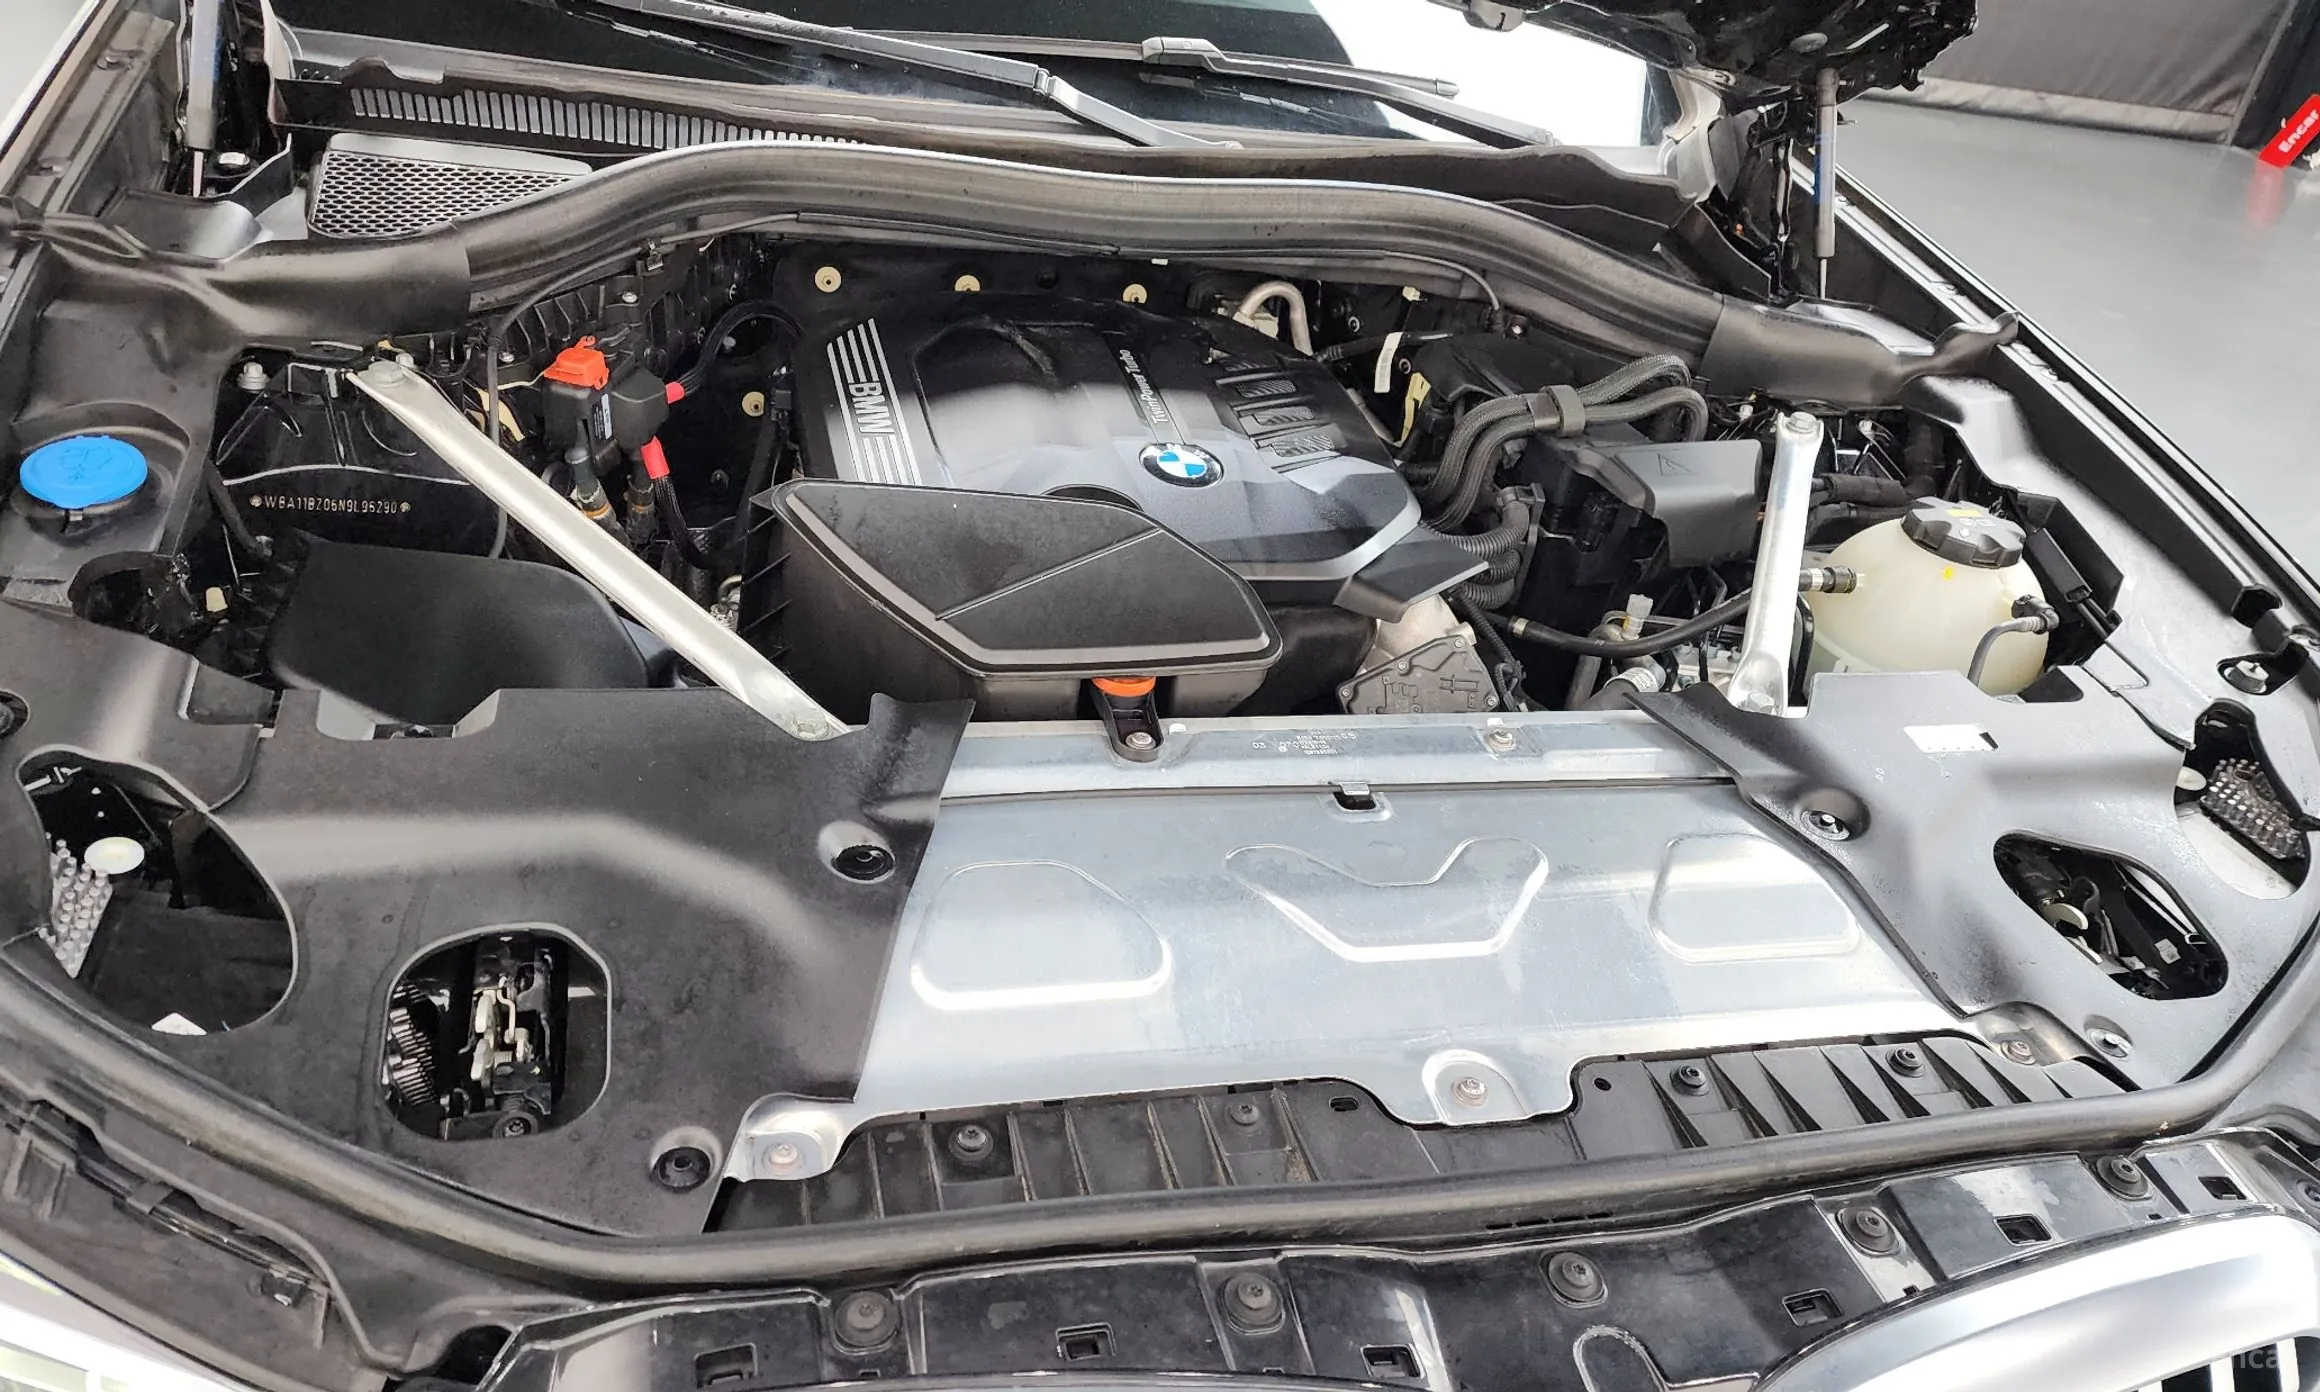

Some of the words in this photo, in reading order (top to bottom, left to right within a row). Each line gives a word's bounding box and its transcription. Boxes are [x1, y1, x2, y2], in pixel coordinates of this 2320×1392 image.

[1119, 349, 1141, 374] Turbo
[849, 382, 895, 433] BMW
[1133, 374, 1169, 424] TwinPower
